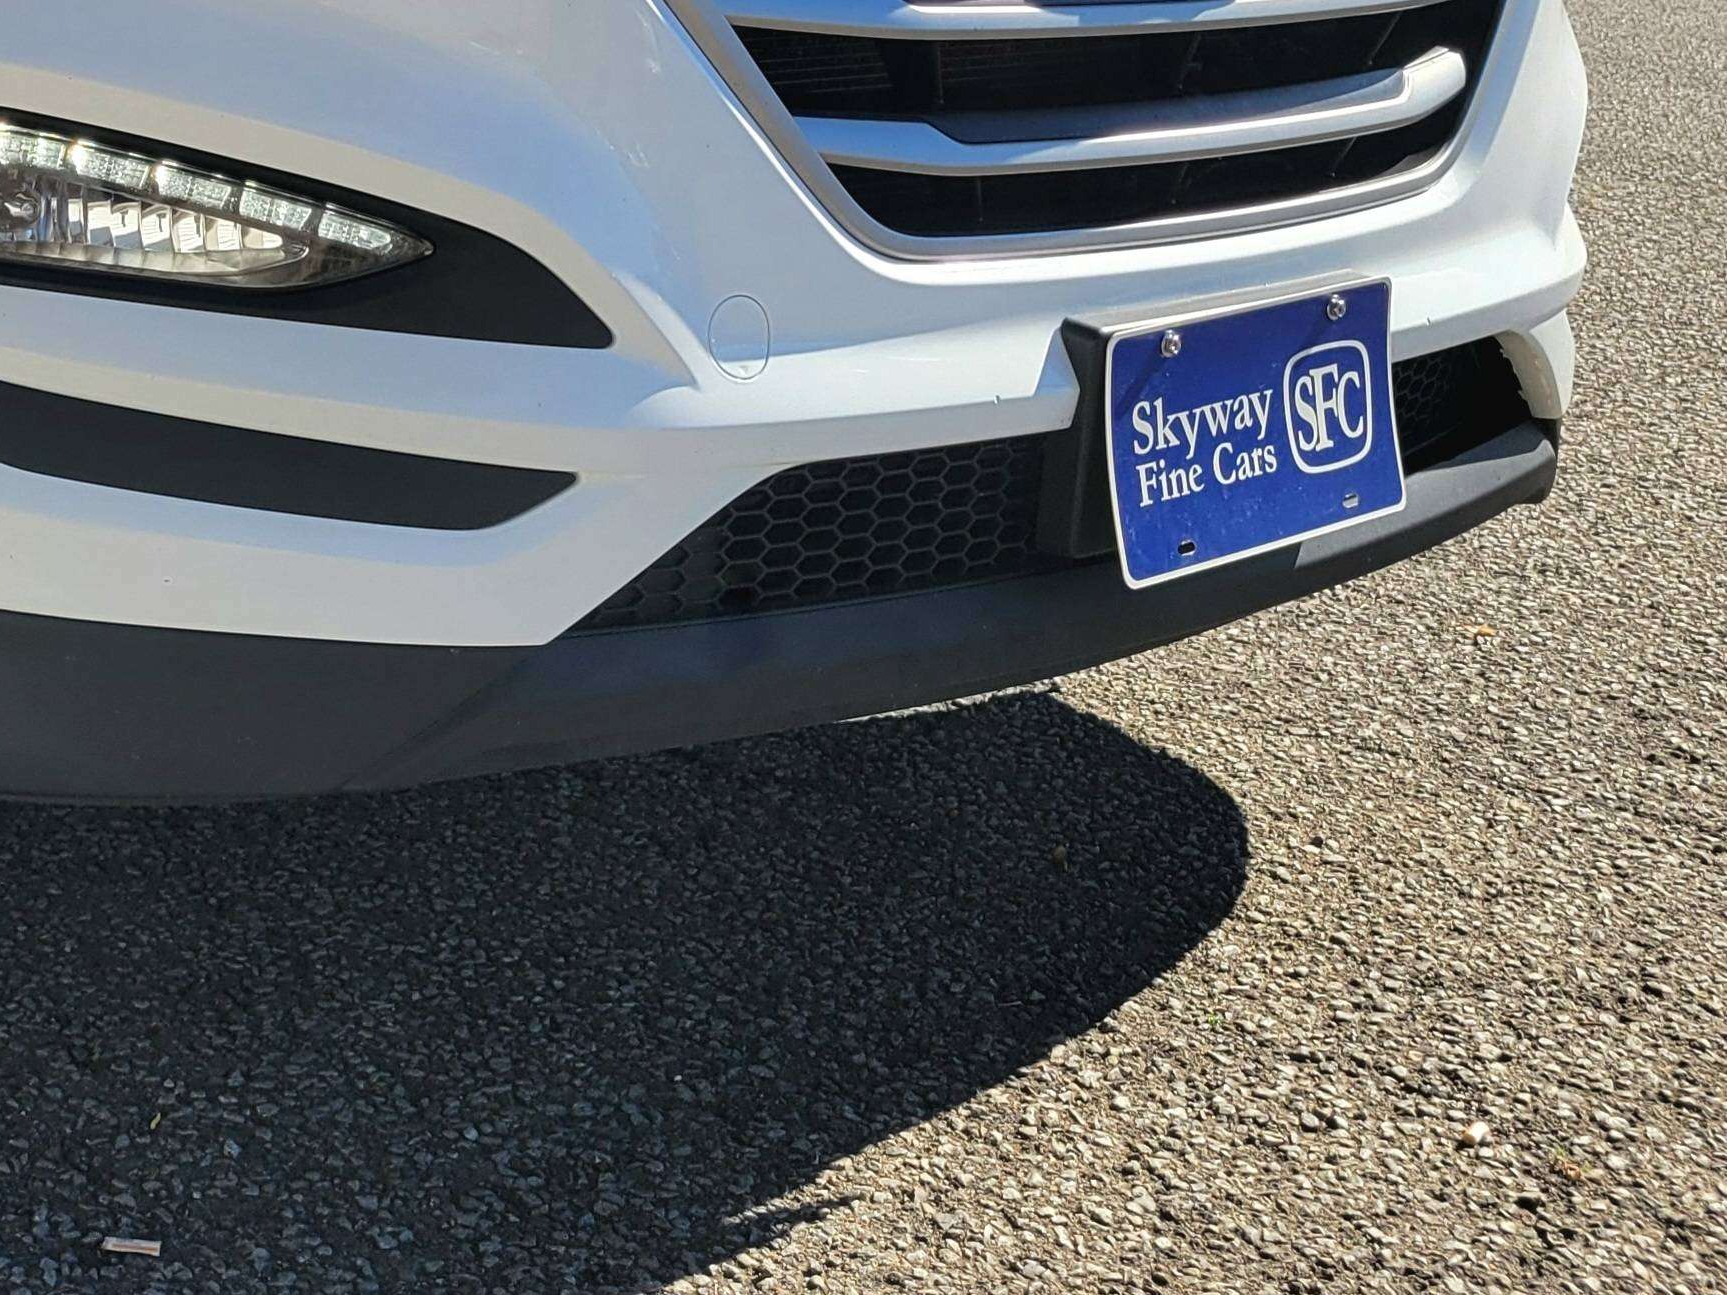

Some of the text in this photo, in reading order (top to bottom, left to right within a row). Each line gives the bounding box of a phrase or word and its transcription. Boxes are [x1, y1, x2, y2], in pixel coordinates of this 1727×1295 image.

[1132, 389, 1273, 459] Skyway
[1294, 363, 1364, 451] SFC
[1136, 442, 1277, 507] Fine Cars
